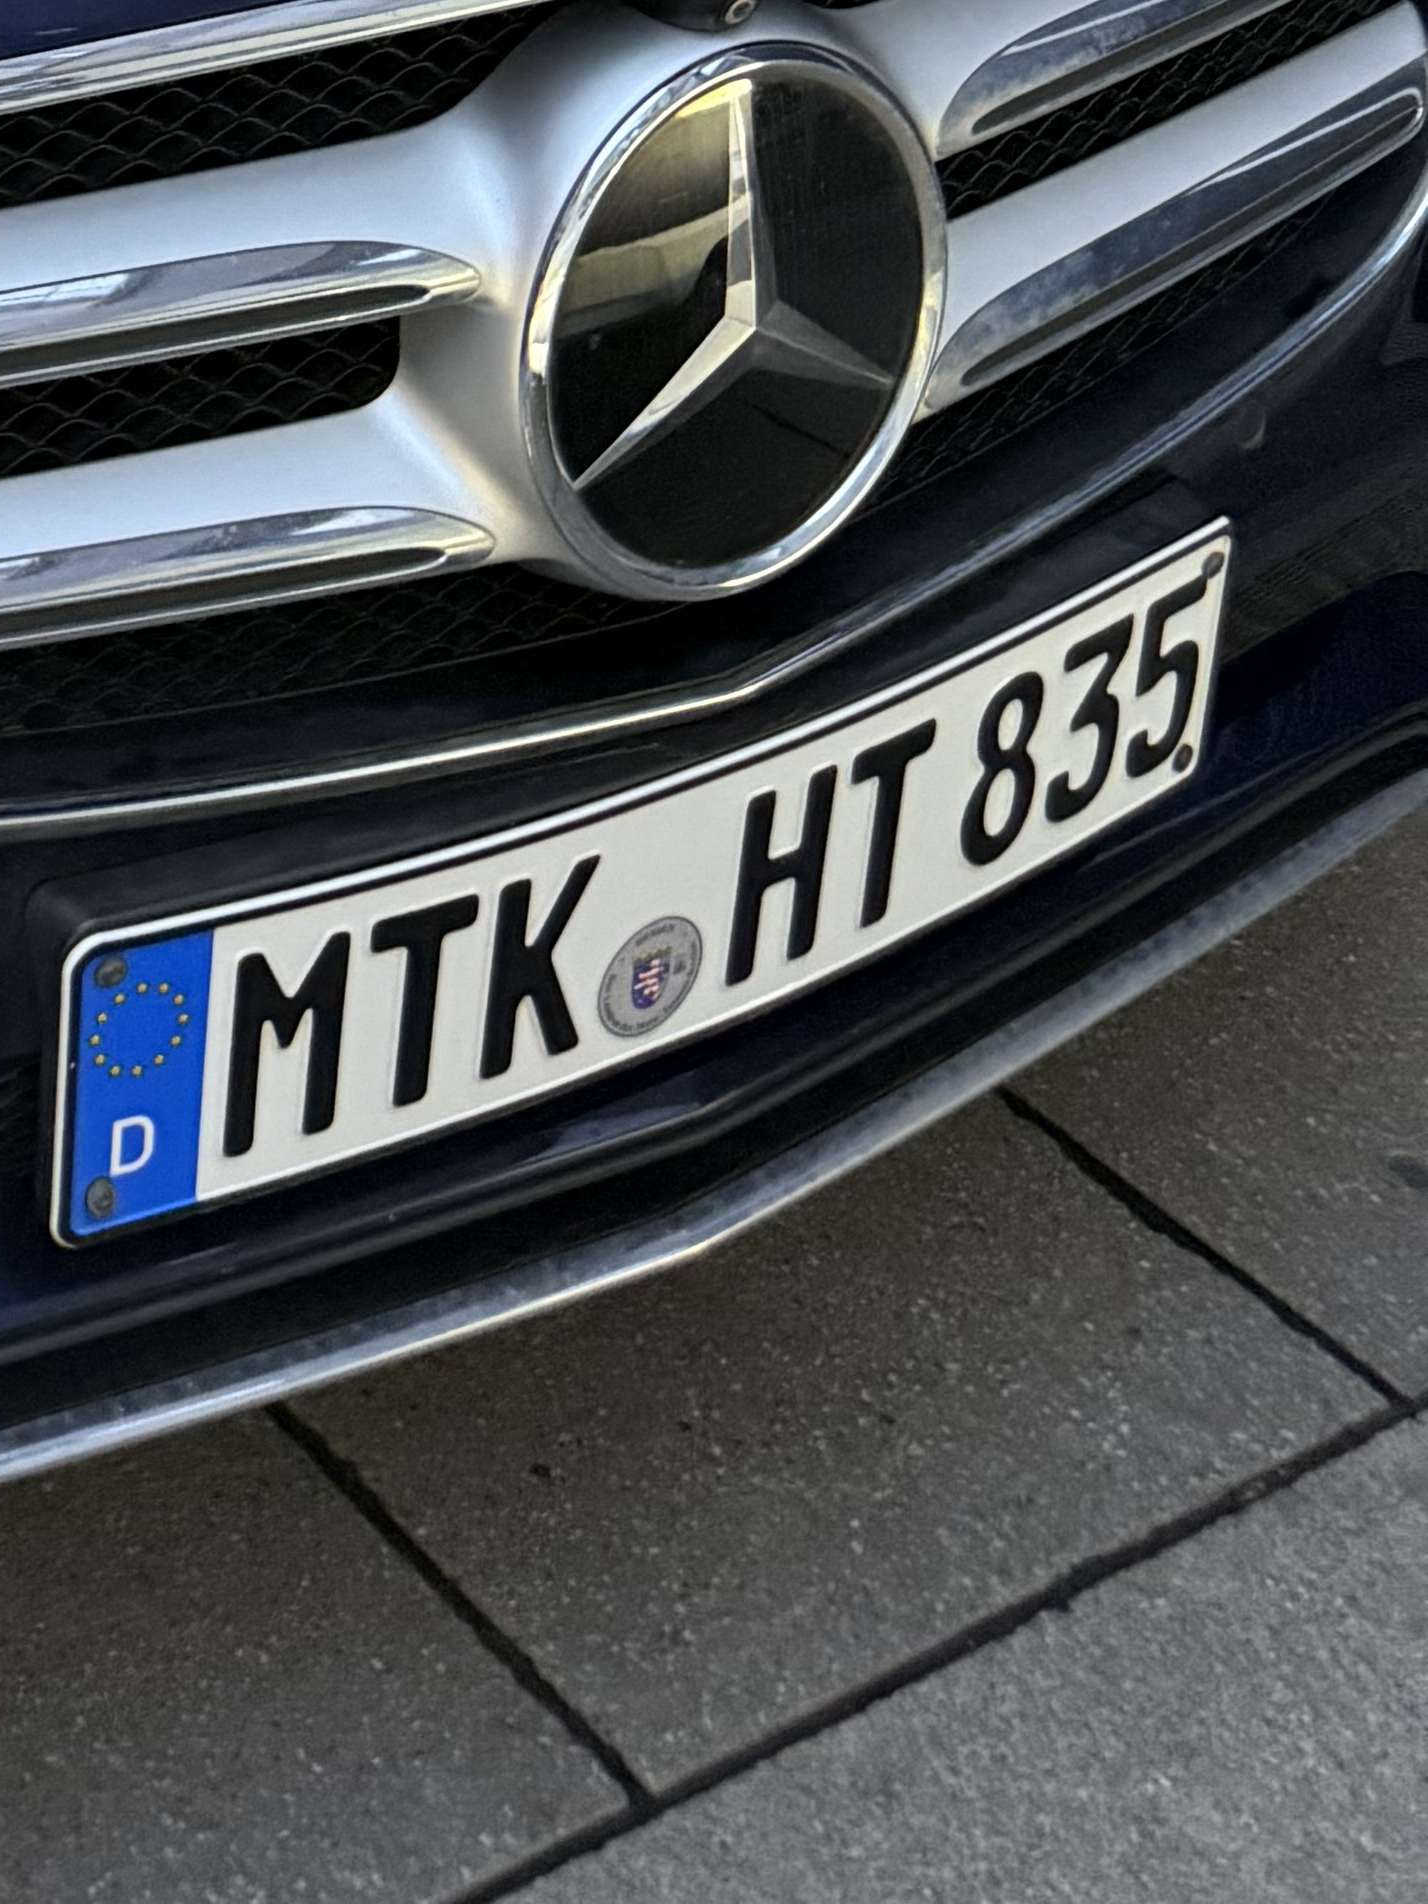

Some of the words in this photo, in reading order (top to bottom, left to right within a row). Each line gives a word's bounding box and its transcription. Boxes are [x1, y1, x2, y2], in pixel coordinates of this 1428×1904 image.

[108, 1113, 156, 1177] D
[222, 853, 601, 1159] MTK
[724, 717, 940, 987] HT
[959, 576, 1211, 869] 835
